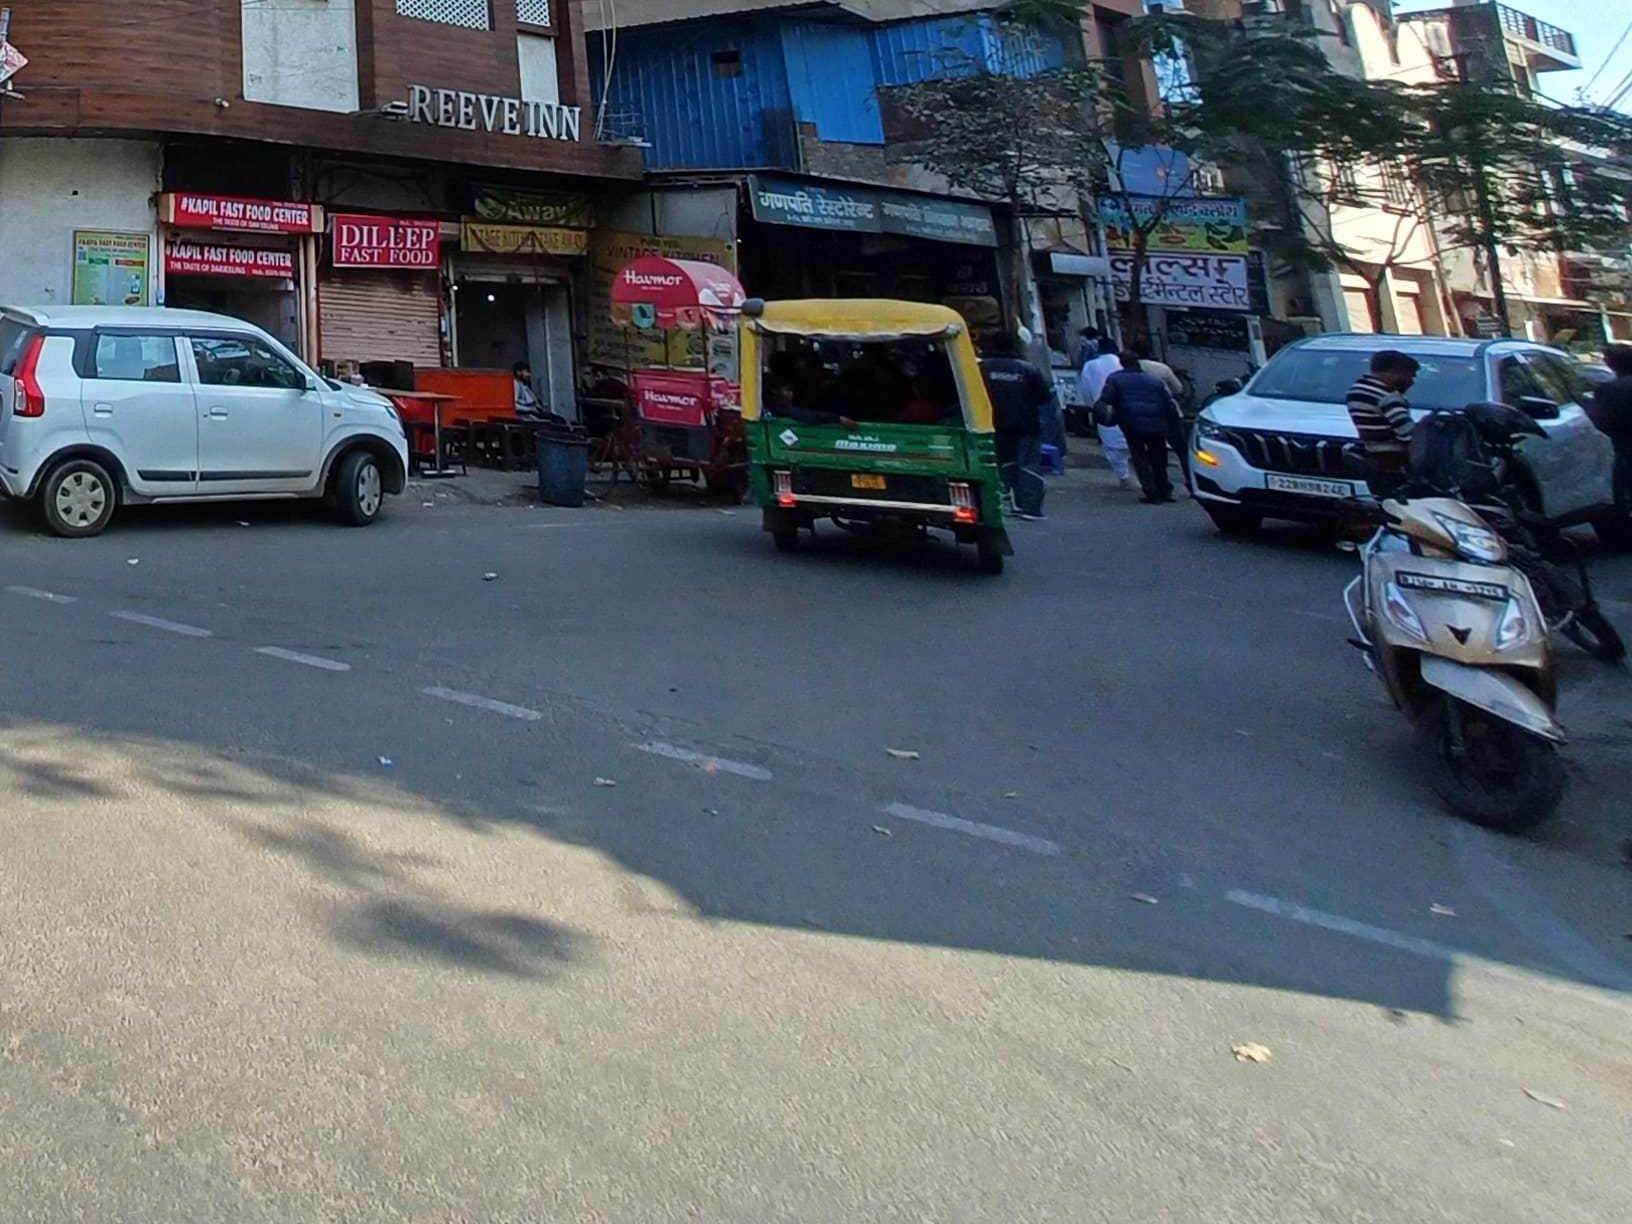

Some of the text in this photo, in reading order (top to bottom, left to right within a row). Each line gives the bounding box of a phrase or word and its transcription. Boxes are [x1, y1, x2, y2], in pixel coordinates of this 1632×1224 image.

[409, 84, 581, 143] REEVE INN
[180, 197, 218, 216] #KAPIL
[220, 201, 244, 219] FAST
[246, 204, 272, 221] FOOD
[273, 208, 309, 225] CENTER
[758, 191, 814, 214] गणपति
[170, 261, 181, 270] THE
[183, 262, 200, 271] TASTE
[201, 263, 209, 272] OF
[204, 246, 228, 263] FAST
[229, 248, 255, 264] FOOD
[256, 251, 292, 267] CENTER
[340, 247, 433, 264] FAST FOOD
